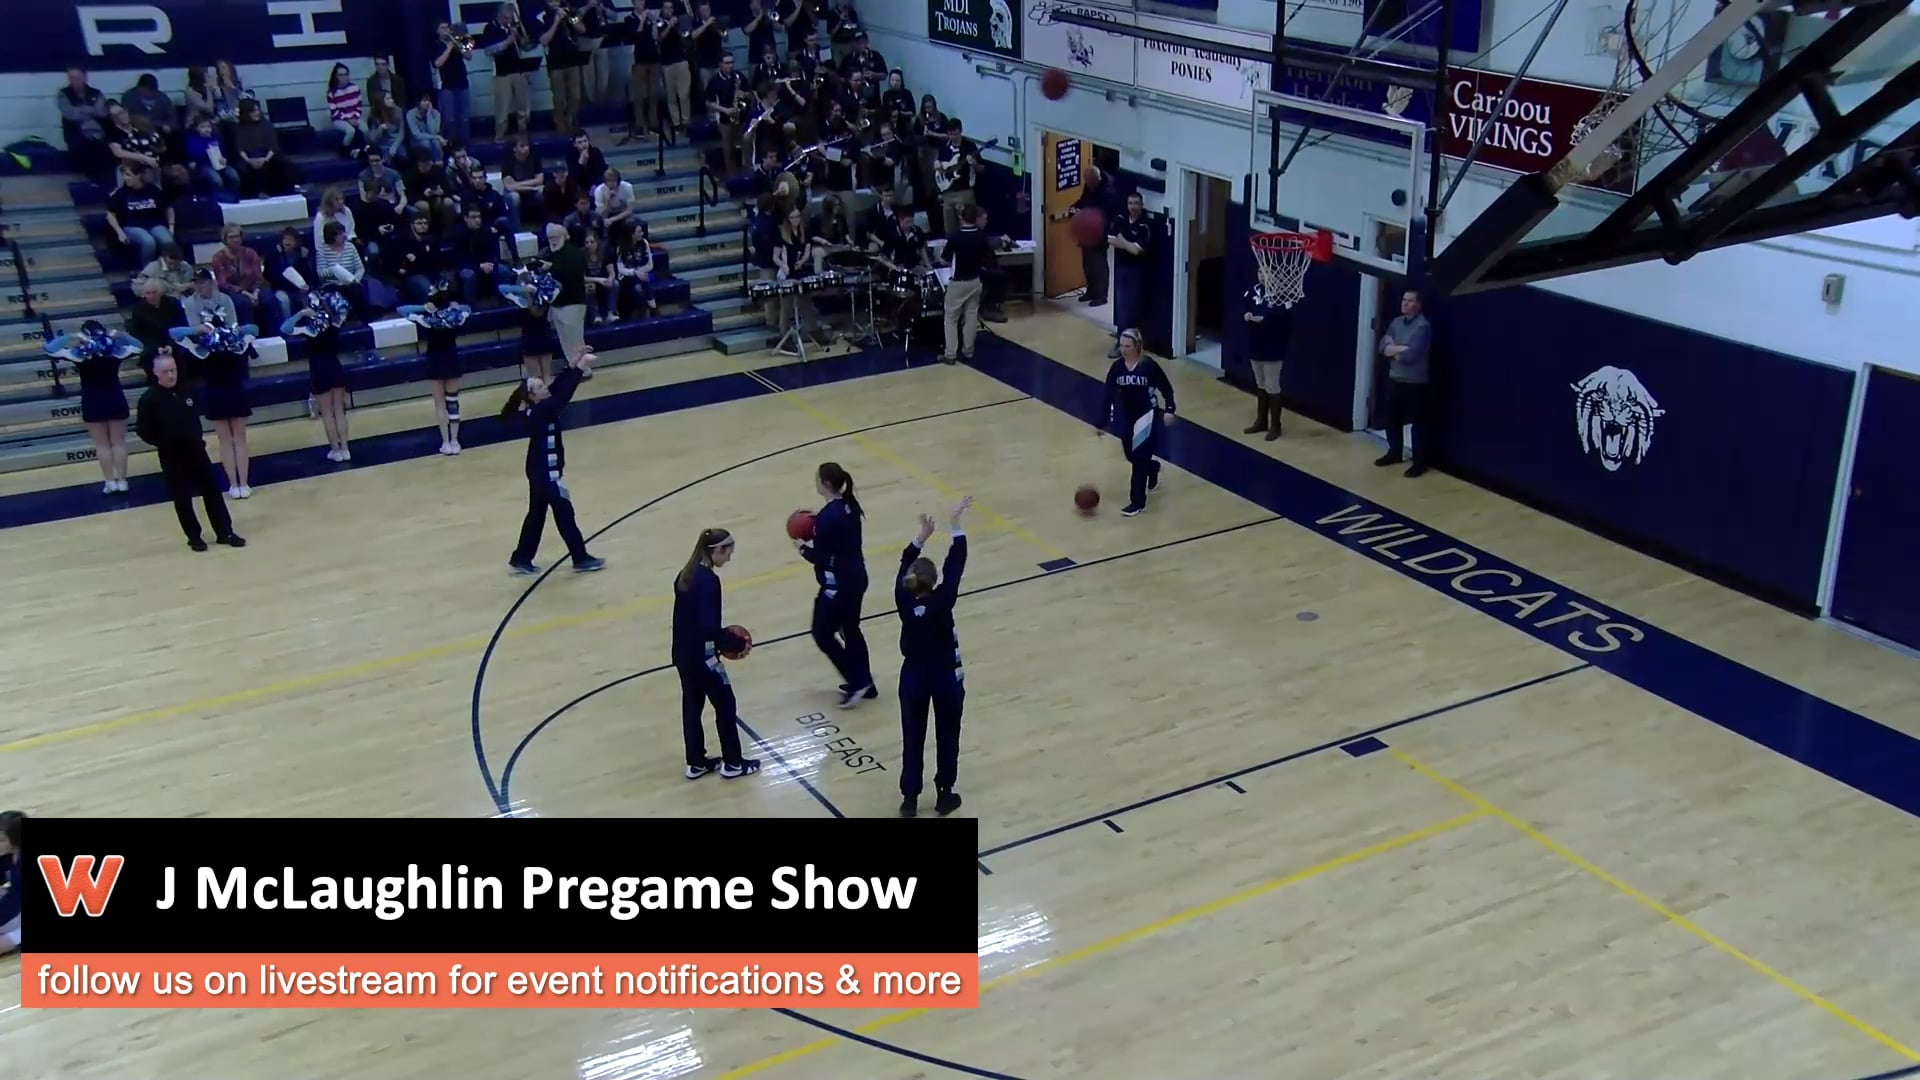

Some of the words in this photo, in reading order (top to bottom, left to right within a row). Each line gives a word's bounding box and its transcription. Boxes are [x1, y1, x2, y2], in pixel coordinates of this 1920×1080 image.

[943, 0, 970, 15] MDI
[1171, 60, 1212, 83] PONIES
[1453, 80, 1551, 124] Caribou
[1448, 112, 1553, 157] VIKINGS
[636, 158, 657, 167] ROW
[656, 186, 677, 195] ROW
[676, 214, 697, 224] ROW
[51, 405, 80, 418] ROW
[66, 448, 97, 461] ROW
[1315, 503, 1645, 653] WILDCATS
[796, 712, 841, 738] BIG
[824, 737, 887, 775] EAST
